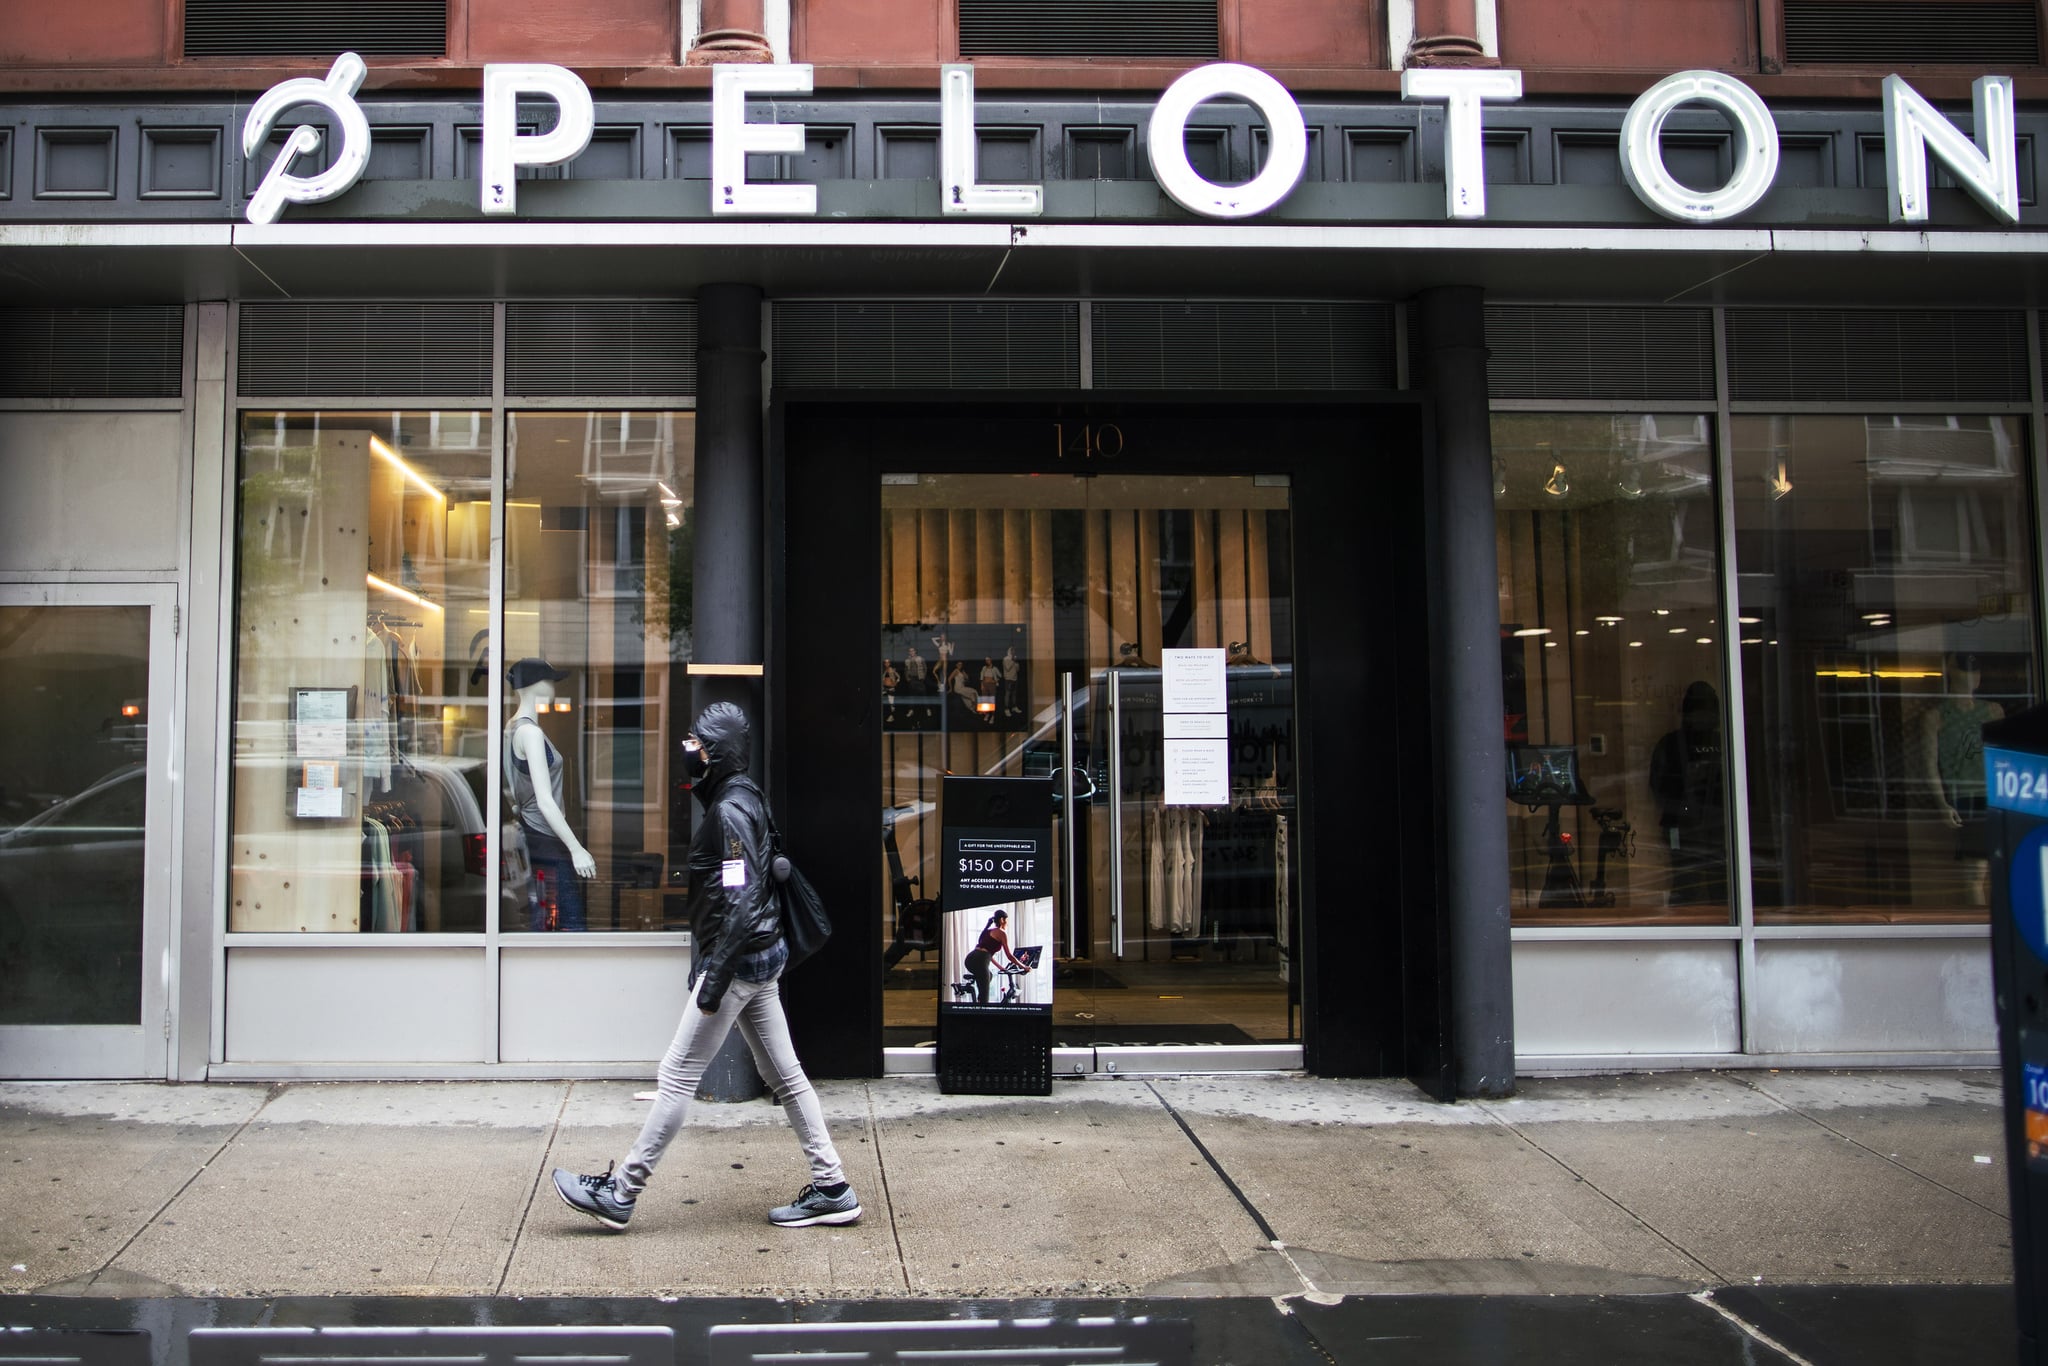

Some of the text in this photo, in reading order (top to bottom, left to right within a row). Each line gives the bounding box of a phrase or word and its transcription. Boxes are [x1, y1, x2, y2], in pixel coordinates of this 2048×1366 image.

[480, 61, 2020, 224] PELOTON
[1053, 423, 1124, 458] 140
[959, 858, 1035, 872] $150 OFF
